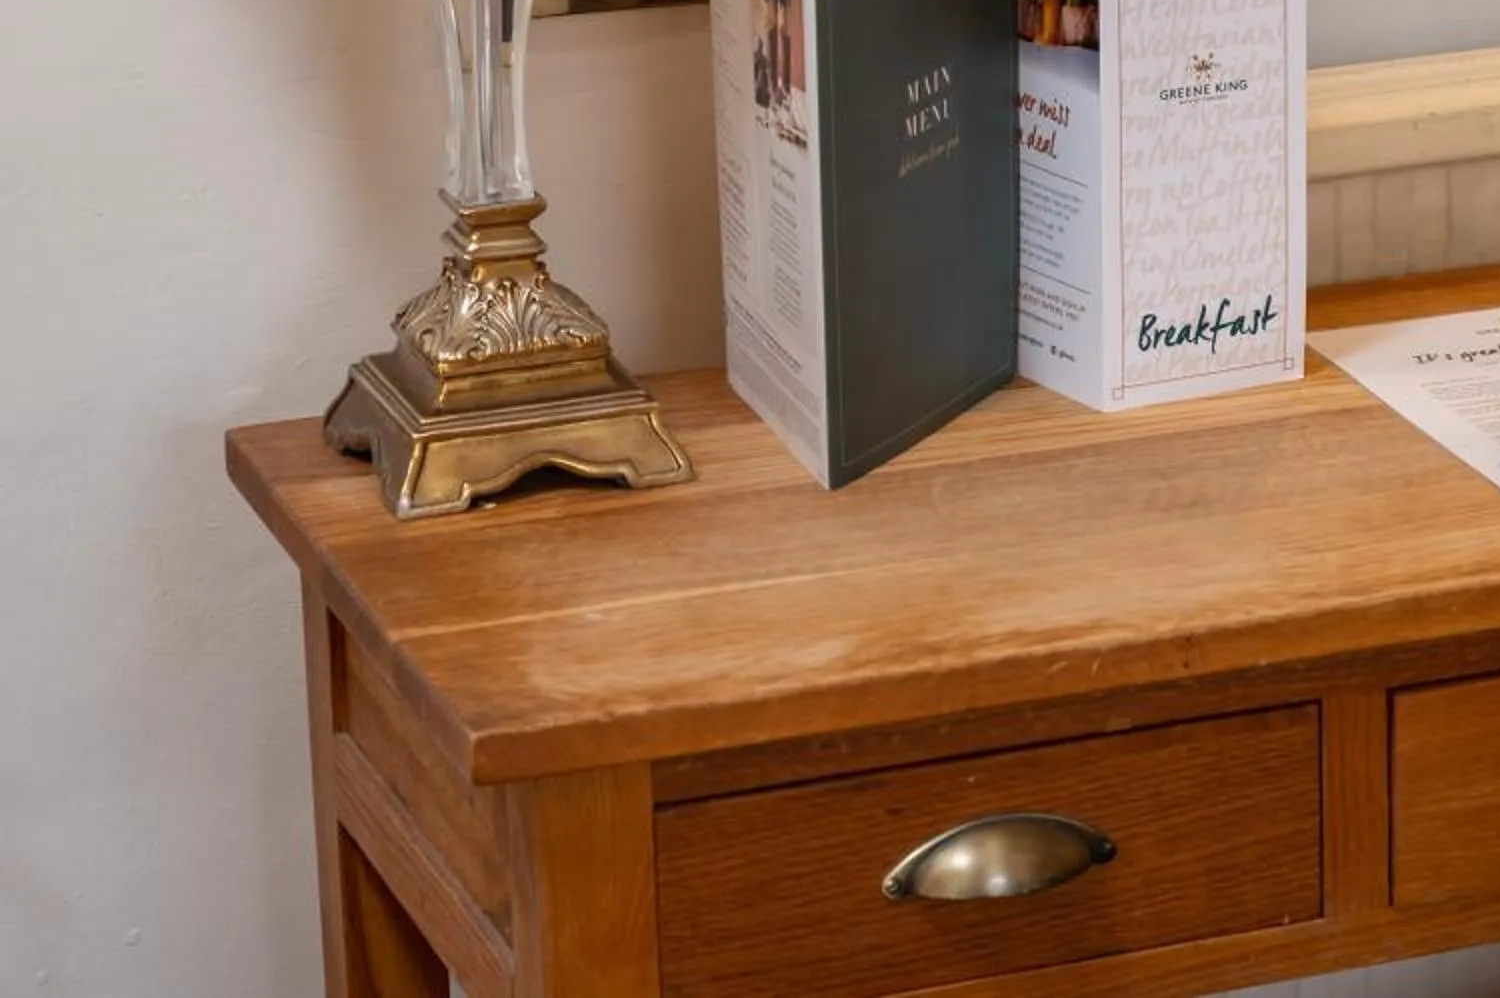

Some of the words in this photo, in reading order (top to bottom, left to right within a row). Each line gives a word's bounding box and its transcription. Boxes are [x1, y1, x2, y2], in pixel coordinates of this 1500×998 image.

[906, 65, 951, 103] MAIN
[1159, 83, 1213, 101] GREENE
[1215, 79, 1249, 94] KING
[905, 97, 952, 137] MENU
[1138, 294, 1278, 354] Breakfast
